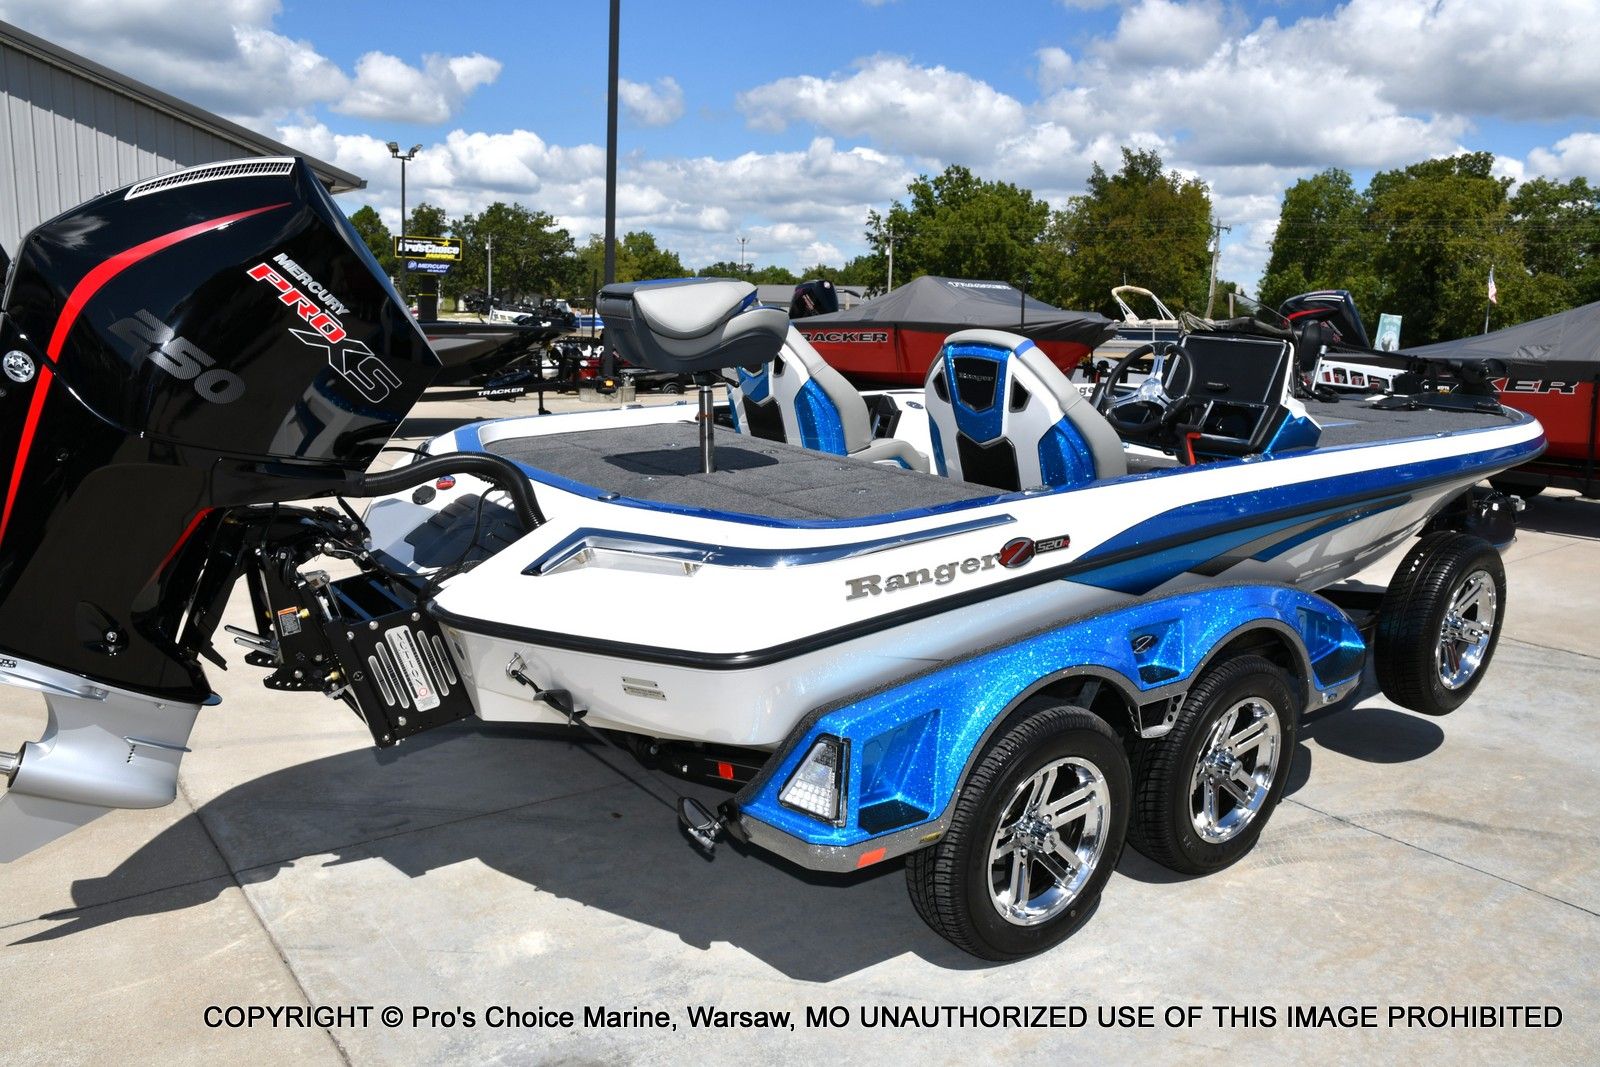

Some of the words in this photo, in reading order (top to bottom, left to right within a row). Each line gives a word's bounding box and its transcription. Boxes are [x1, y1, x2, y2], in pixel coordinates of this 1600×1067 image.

[246, 262, 347, 344] PRO
[273, 252, 351, 316] MERCURY
[107, 308, 246, 404] 250
[288, 308, 403, 404] XS
[800, 331, 889, 343] RACKER
[477, 387, 524, 396] TRACKER
[845, 552, 1001, 601] Ranger
